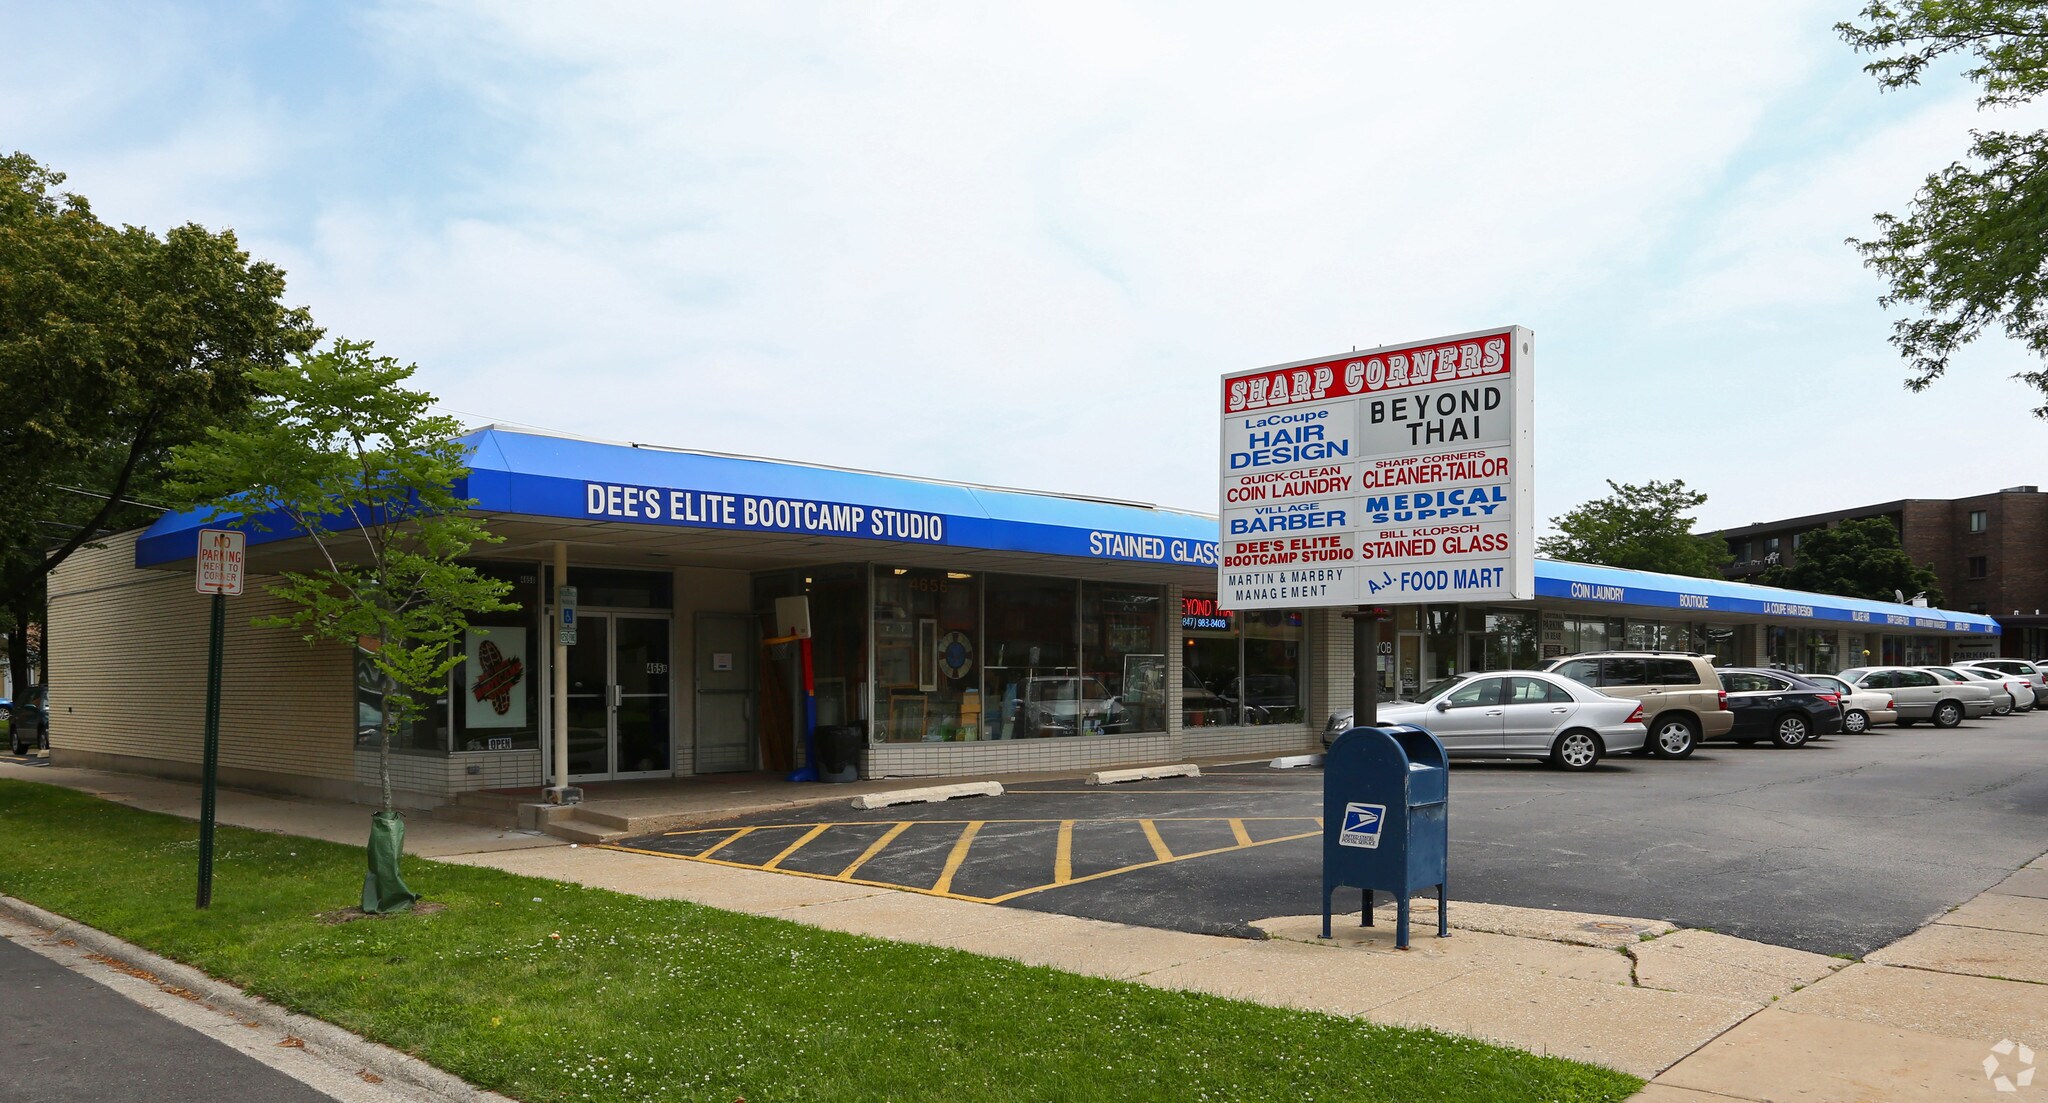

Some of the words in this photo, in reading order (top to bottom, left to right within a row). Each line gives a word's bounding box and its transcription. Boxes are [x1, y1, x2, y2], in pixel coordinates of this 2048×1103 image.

[1230, 366, 1333, 411] SHARP
[1345, 337, 1505, 393] CORNERS
[1371, 387, 1501, 424] BEYOND
[1246, 411, 1328, 429] LaCoupe
[1250, 424, 1324, 449] HAIR
[1407, 416, 1479, 445] THAI
[1231, 440, 1348, 469] DESIGN
[1376, 458, 1418, 469] SHARP
[1423, 450, 1485, 465] CORNERS
[1241, 466, 1340, 485] QUICK-CLEAN
[1363, 458, 1508, 489] CLEANER-TAILOR
[1227, 482, 1266, 503] COIN
[1272, 476, 1352, 498] LAUNDRY
[1255, 503, 1319, 515] VILLAGE
[1366, 487, 1506, 512] MEDICAL
[588, 484, 660, 519] DEE'S
[671, 492, 735, 524] ELITE
[744, 498, 864, 532] BOOTCAMP
[872, 510, 942, 541] STUDIO
[1373, 504, 1499, 524] SUPPLY
[1231, 511, 1346, 535] BARBER
[1380, 529, 1407, 538] BILL
[1413, 525, 1479, 537] KLOPSCH
[214, 536, 230, 548] NO
[1090, 531, 1164, 560] STAINED
[1236, 541, 1284, 554] DEE'S
[1291, 537, 1340, 550] ELITE
[1362, 538, 1435, 560] STAINED
[1442, 534, 1508, 554] GLASS
[202, 549, 240, 563] PARKING
[1225, 553, 1297, 567] BOOTCAMP
[1302, 548, 1354, 562] STUDIO
[204, 562, 224, 571] HERE
[229, 564, 238, 572] TO
[204, 572, 236, 581] CORNER
[1229, 573, 1274, 586] MARTIN
[1280, 572, 1286, 582] &
[1292, 570, 1343, 582] MARBRY
[1368, 572, 1396, 594] A.J.
[1401, 570, 1448, 591] FOOD
[1454, 567, 1503, 588] MART
[1236, 585, 1326, 600] MANAGEMENT
[1571, 583, 1590, 598] COIN
[1592, 586, 1624, 602] LAUNDRY
[1680, 594, 1708, 608] BOUTIQUE
[1182, 598, 1211, 616] EYOND
[1787, 604, 1797, 615] HAIR
[1182, 618, 1196, 629] 847)
[1377, 642, 1392, 654] YOB
[490, 739, 510, 749] OPEN
